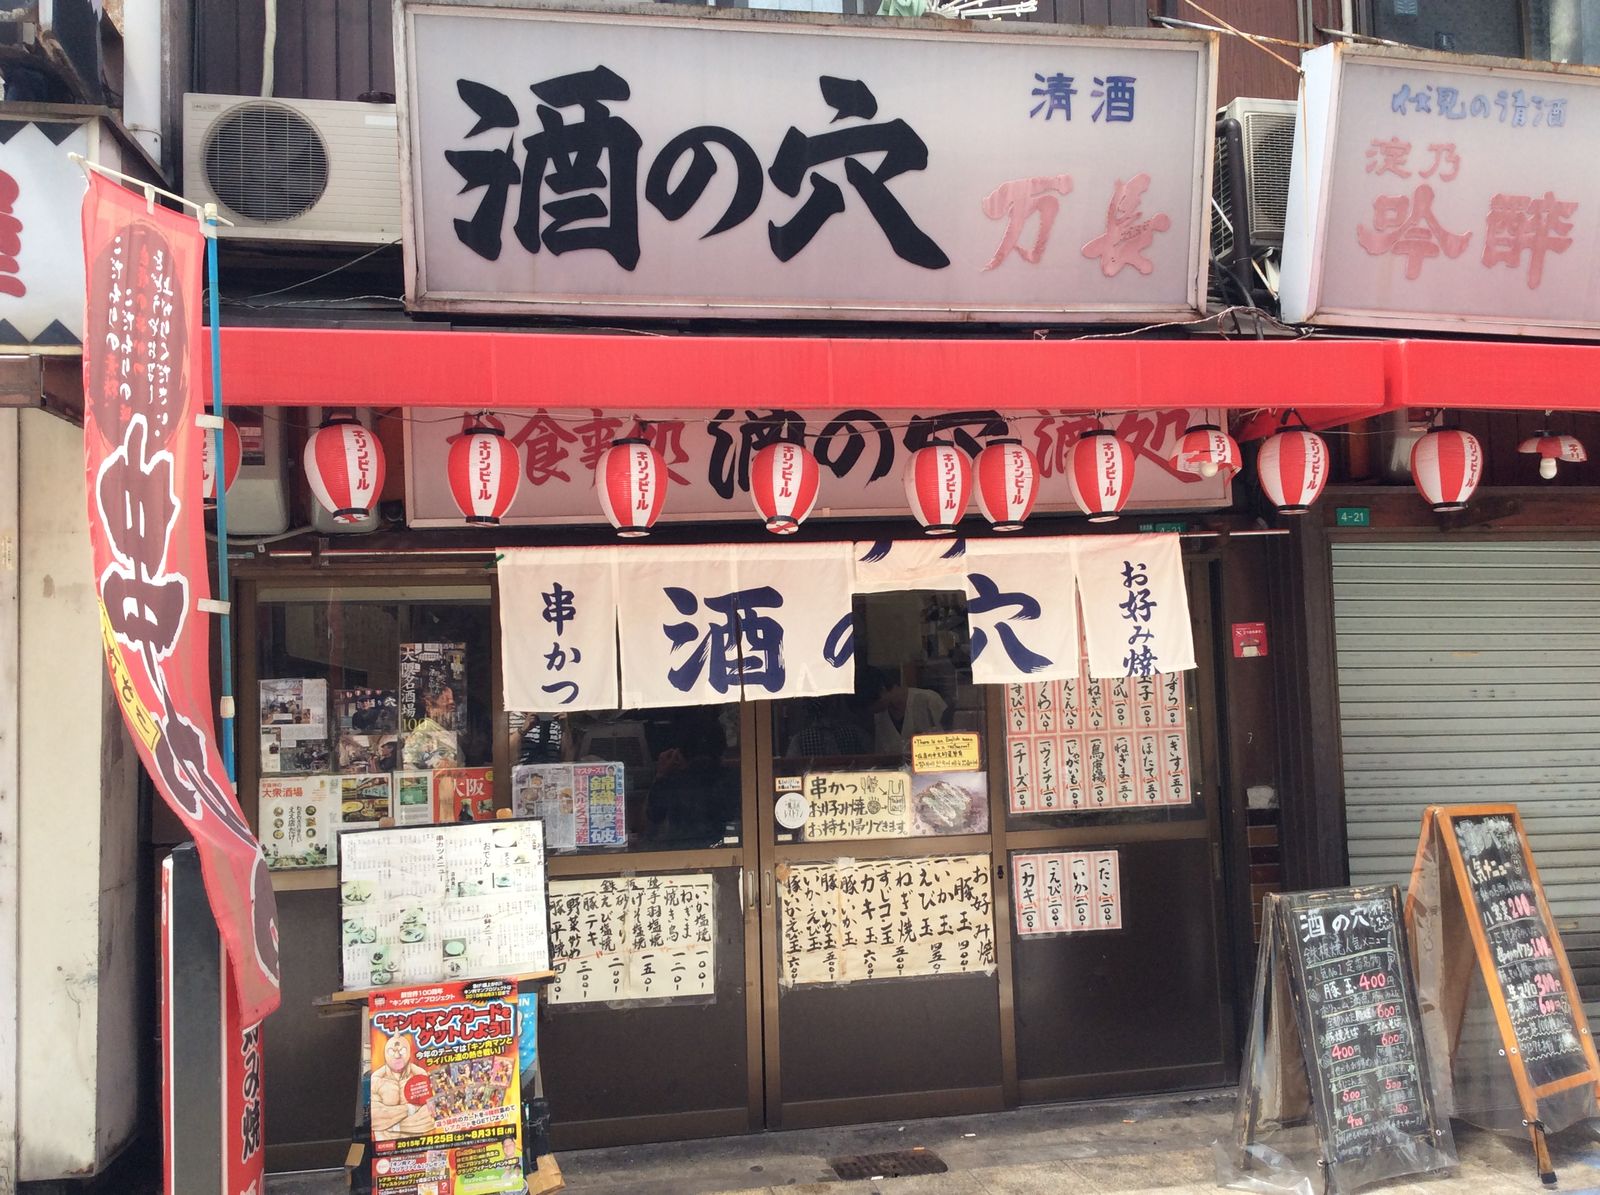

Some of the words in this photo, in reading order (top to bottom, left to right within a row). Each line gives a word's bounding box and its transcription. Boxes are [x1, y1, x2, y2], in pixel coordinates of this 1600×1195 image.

[1028, 72, 1136, 123] 清酒
[1391, 84, 1567, 128] 伏見の清酒
[446, 65, 950, 272] 酒の穴
[980, 172, 1173, 278] 万長
[352, 430, 369, 491] キリンビール
[478, 440, 492, 500] キリンビール
[636, 450, 649, 511] キリンビール
[779, 445, 793, 498] キリンビール
[944, 453, 956, 510] キリンビール
[1012, 451, 1025, 505] キリンビール
[1103, 442, 1116, 497] キリンビール
[1306, 436, 1320, 490] キリンビール
[1463, 435, 1478, 488] キリンビール
[1341, 512, 1364, 522] 4-21
[541, 582, 581, 705] 串かつ
[1119, 560, 1160, 677] お好み焼
[262, 787, 304, 798] 大衆酒場
[809, 799, 867, 818] お好み焼
[810, 776, 858, 800] 串かつ
[483, 842, 492, 868] おでん
[971, 865, 994, 965] お好み焼
[1300, 904, 1370, 943] 酒の穴
